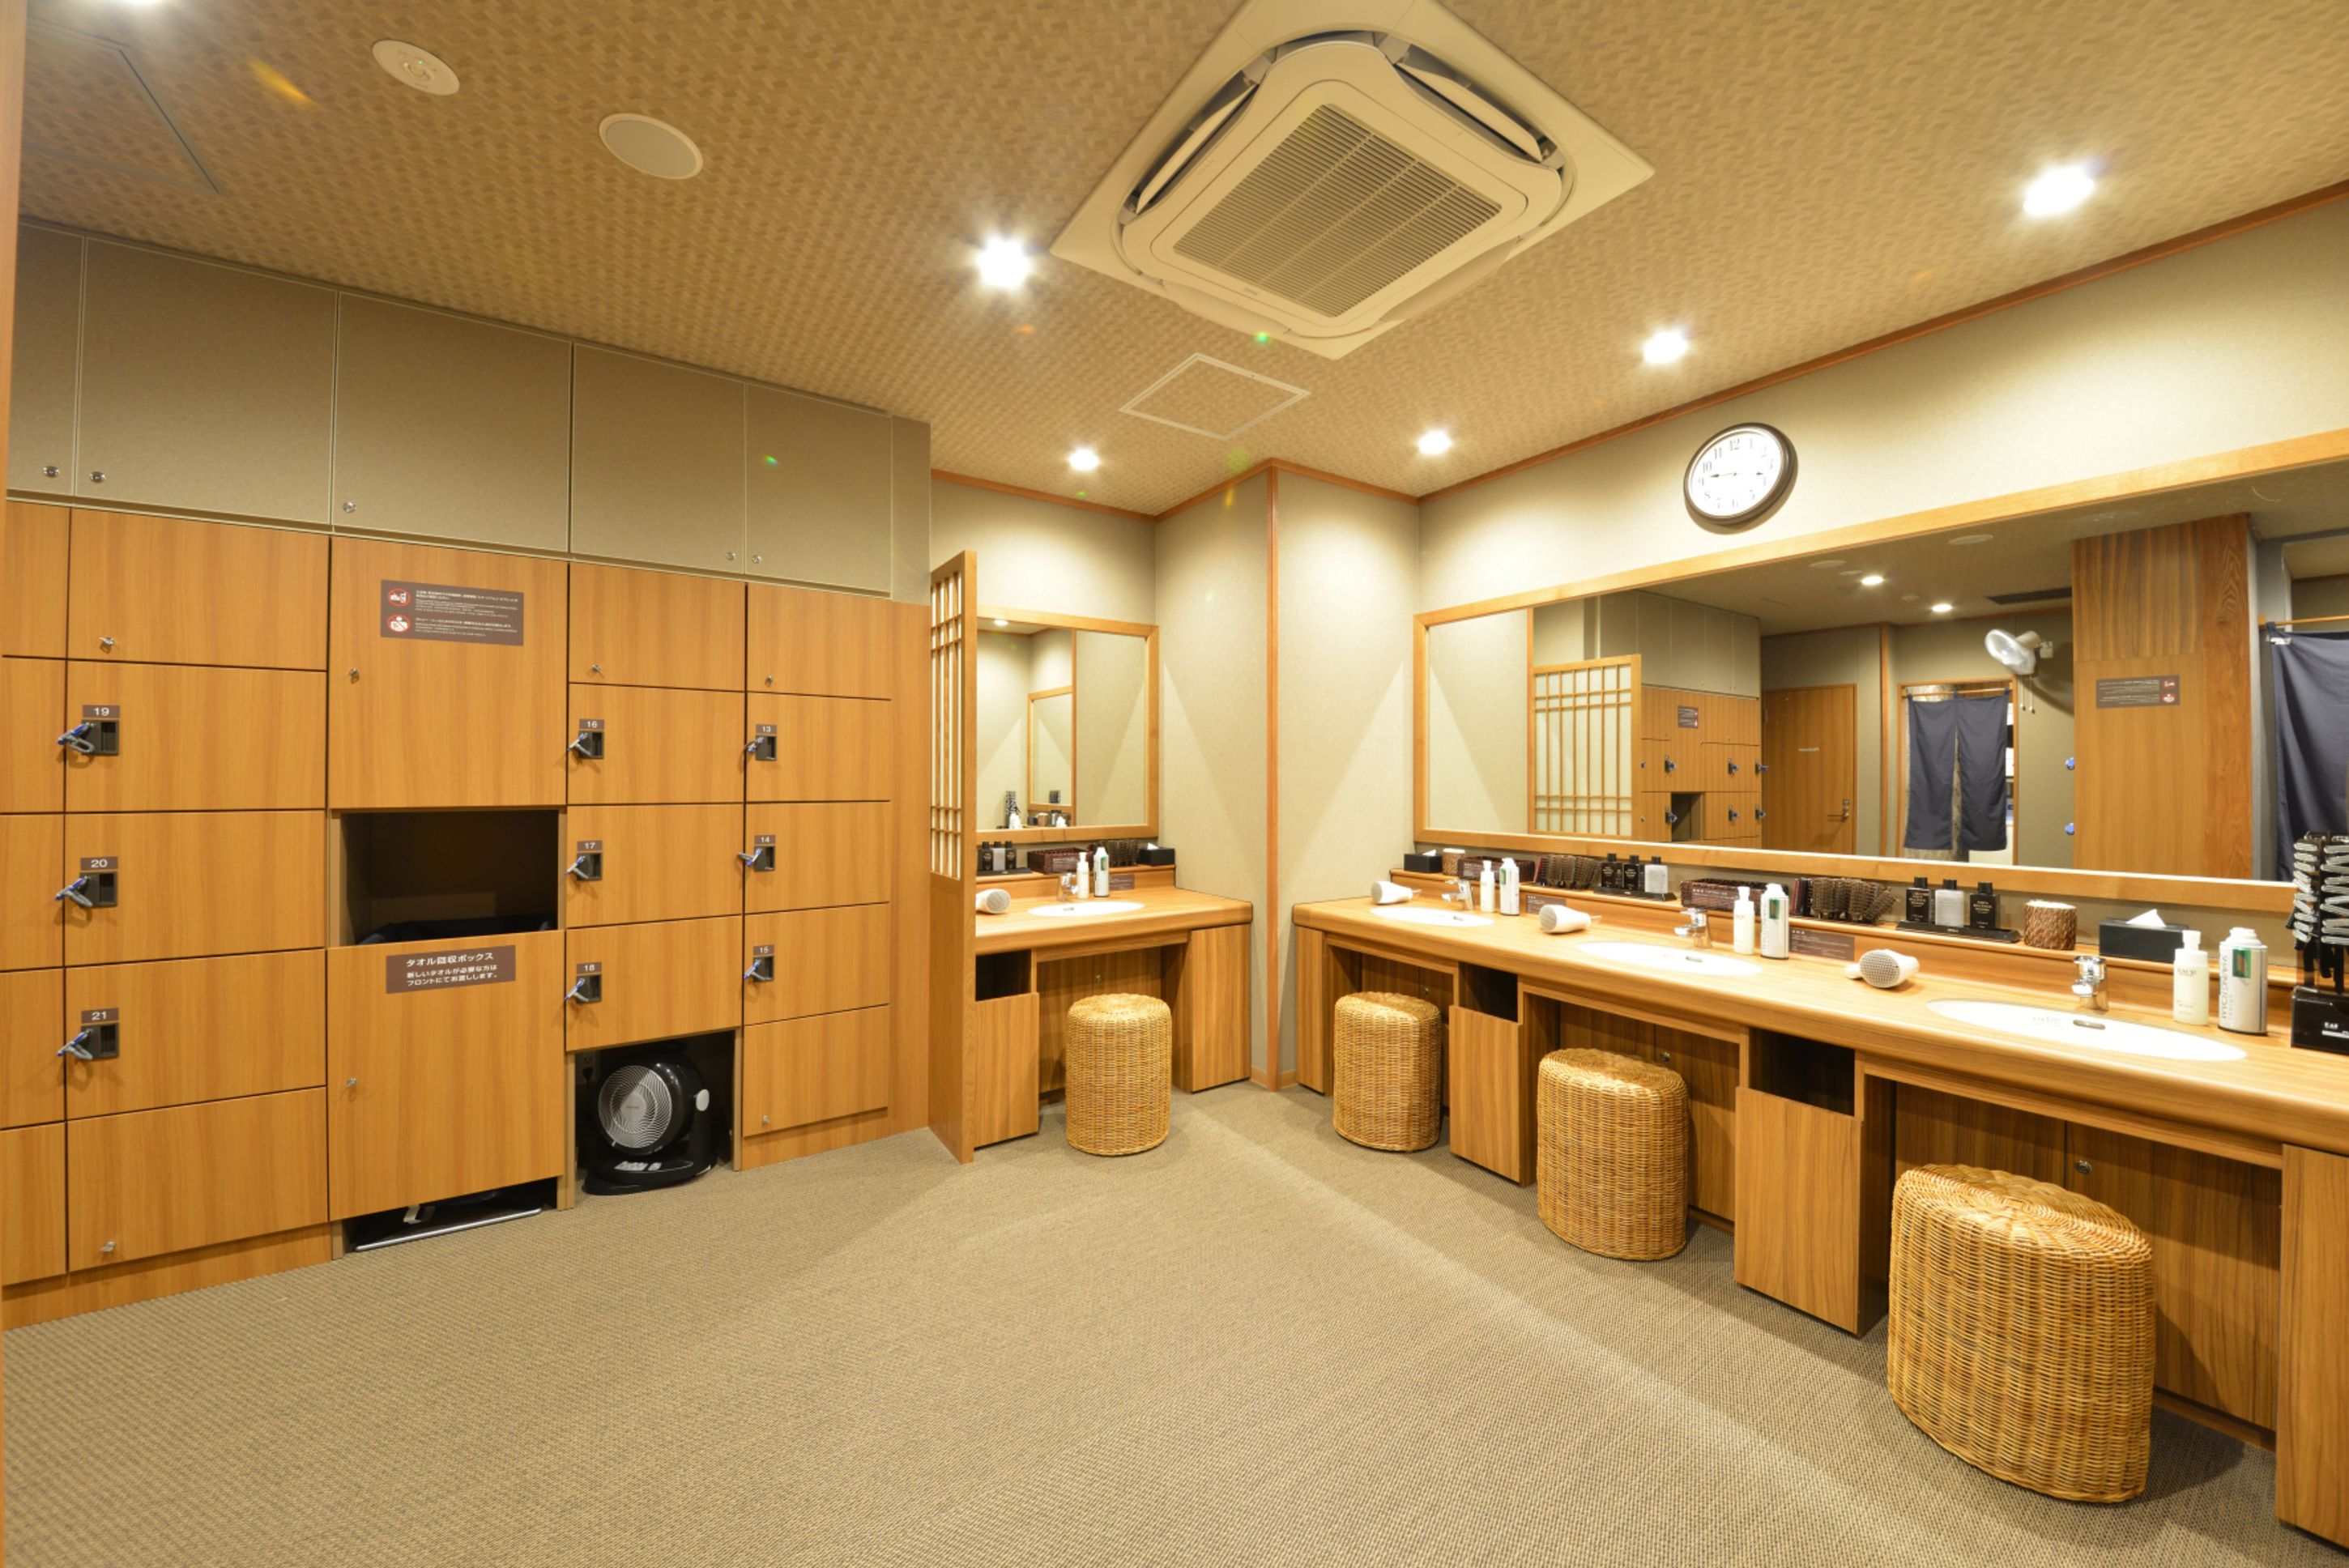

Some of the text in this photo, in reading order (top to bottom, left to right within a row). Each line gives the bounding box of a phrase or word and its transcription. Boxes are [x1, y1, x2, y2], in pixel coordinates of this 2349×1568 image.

[1729, 438, 1740, 451] 12
[1714, 447, 1722, 459] 11
[1703, 461, 1712, 473] 10
[94, 707, 109, 716] 19
[91, 859, 108, 868] 20
[406, 952, 494, 967] タオル回収ボックス
[584, 964, 595, 972] 18
[92, 1011, 107, 1020] 21
